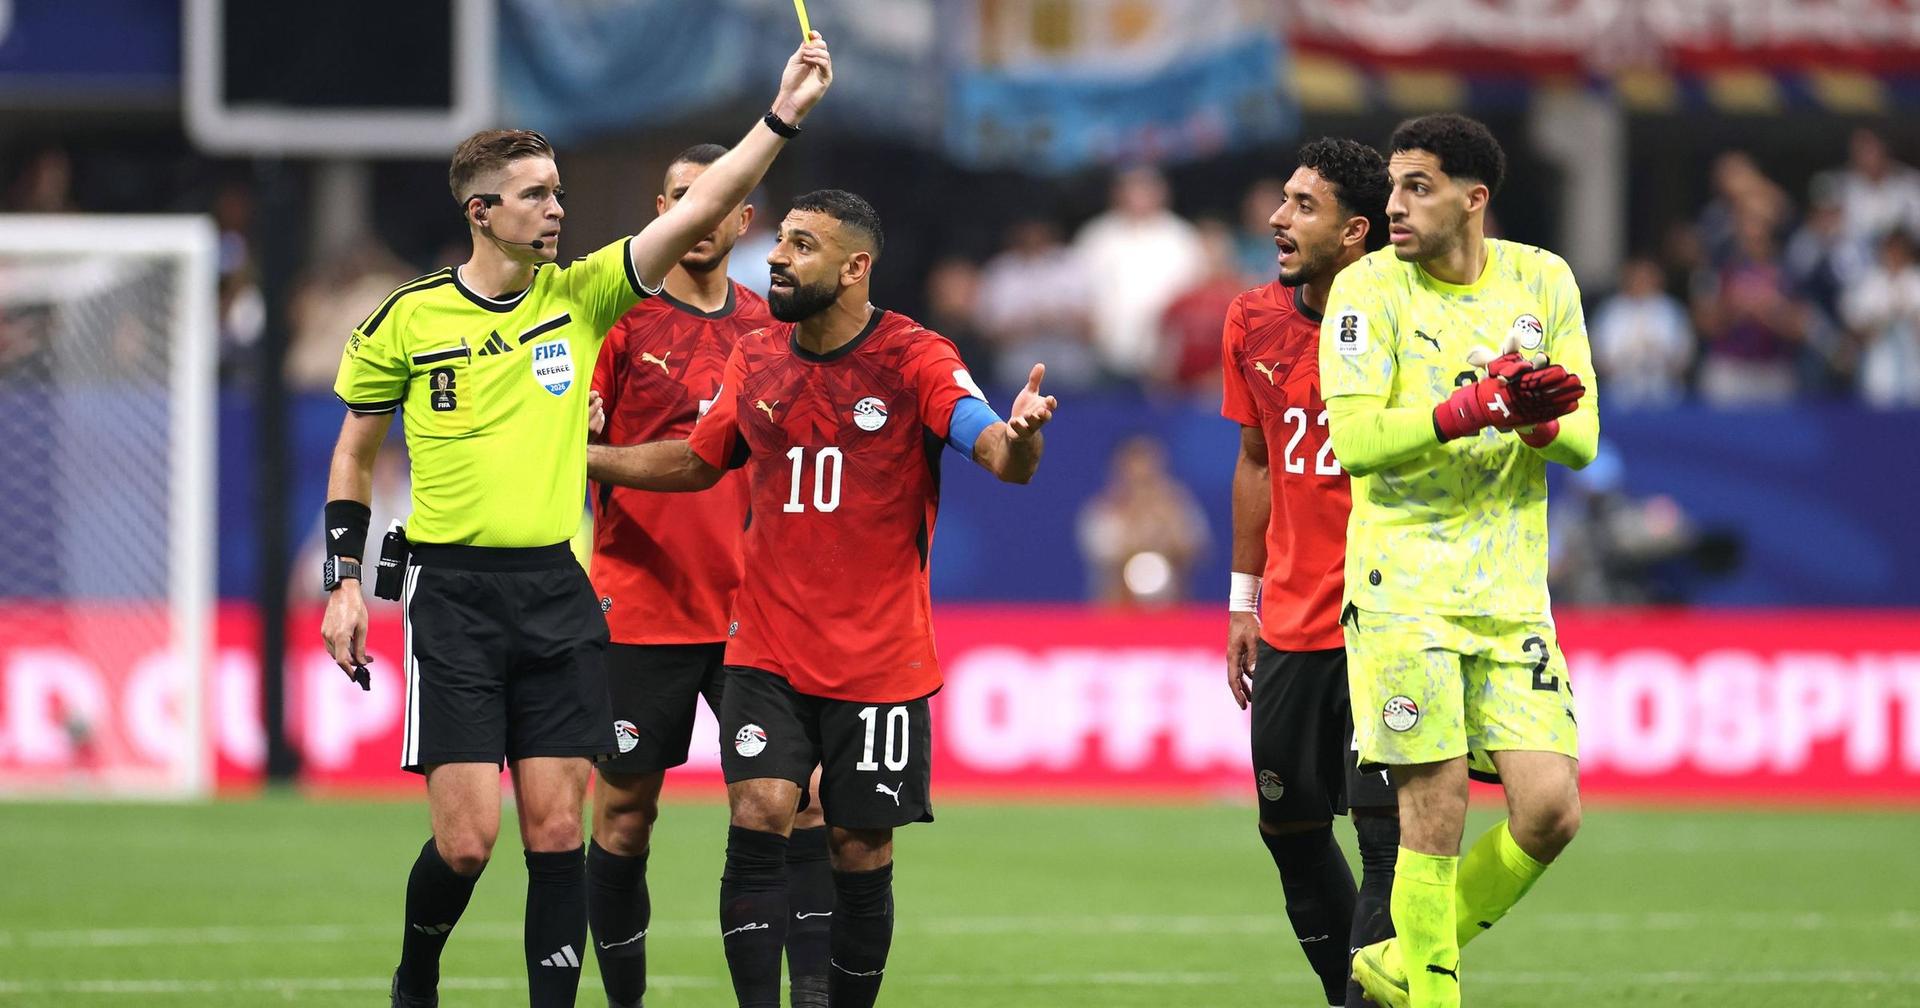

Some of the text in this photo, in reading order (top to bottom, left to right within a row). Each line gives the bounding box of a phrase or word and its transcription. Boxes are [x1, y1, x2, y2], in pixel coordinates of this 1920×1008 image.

[535, 343, 567, 361] FIFA
[536, 364, 571, 376] REFEREE
[1283, 407, 1341, 477] 22
[783, 446, 843, 513] 10
[1521, 636, 1574, 698] 2
[0, 648, 401, 773] D CUP
[856, 706, 910, 771] 10
